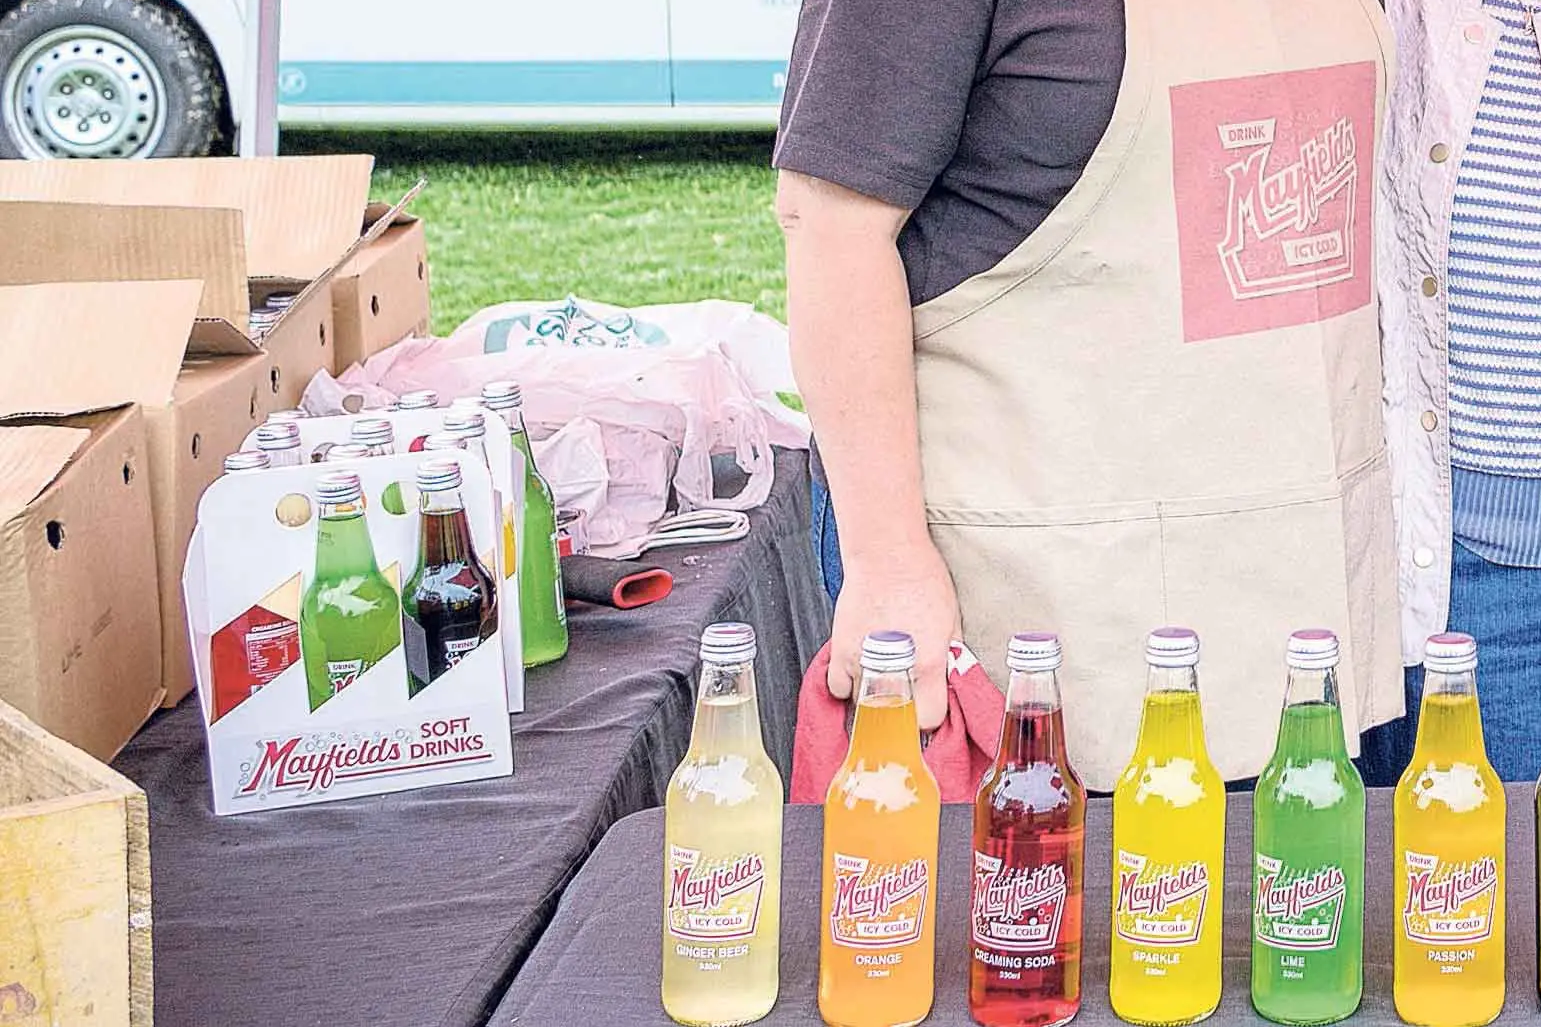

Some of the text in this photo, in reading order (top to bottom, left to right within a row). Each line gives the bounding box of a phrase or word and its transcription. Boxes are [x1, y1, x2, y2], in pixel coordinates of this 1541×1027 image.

[1228, 125, 1266, 142] DRINK
[1218, 118, 1356, 247] Mayfields
[421, 717, 470, 738] SOFT
[240, 735, 484, 792] Mayfields DRINKS
[669, 854, 762, 908] Mayfields
[832, 862, 927, 917] Mayfields
[975, 864, 1065, 921] Mayfields
[1117, 865, 1207, 915] Mayfields
[1256, 870, 1344, 918] Mayfields
[1404, 859, 1495, 913] Mayfields
[676, 944, 748, 958] GINGER BEER
[856, 953, 903, 964] ORANGE
[975, 948, 1055, 968] CREAMING SODA
[1132, 951, 1180, 964] SPARKLE
[1281, 956, 1304, 966] LIME
[1428, 950, 1475, 962] PASSION
